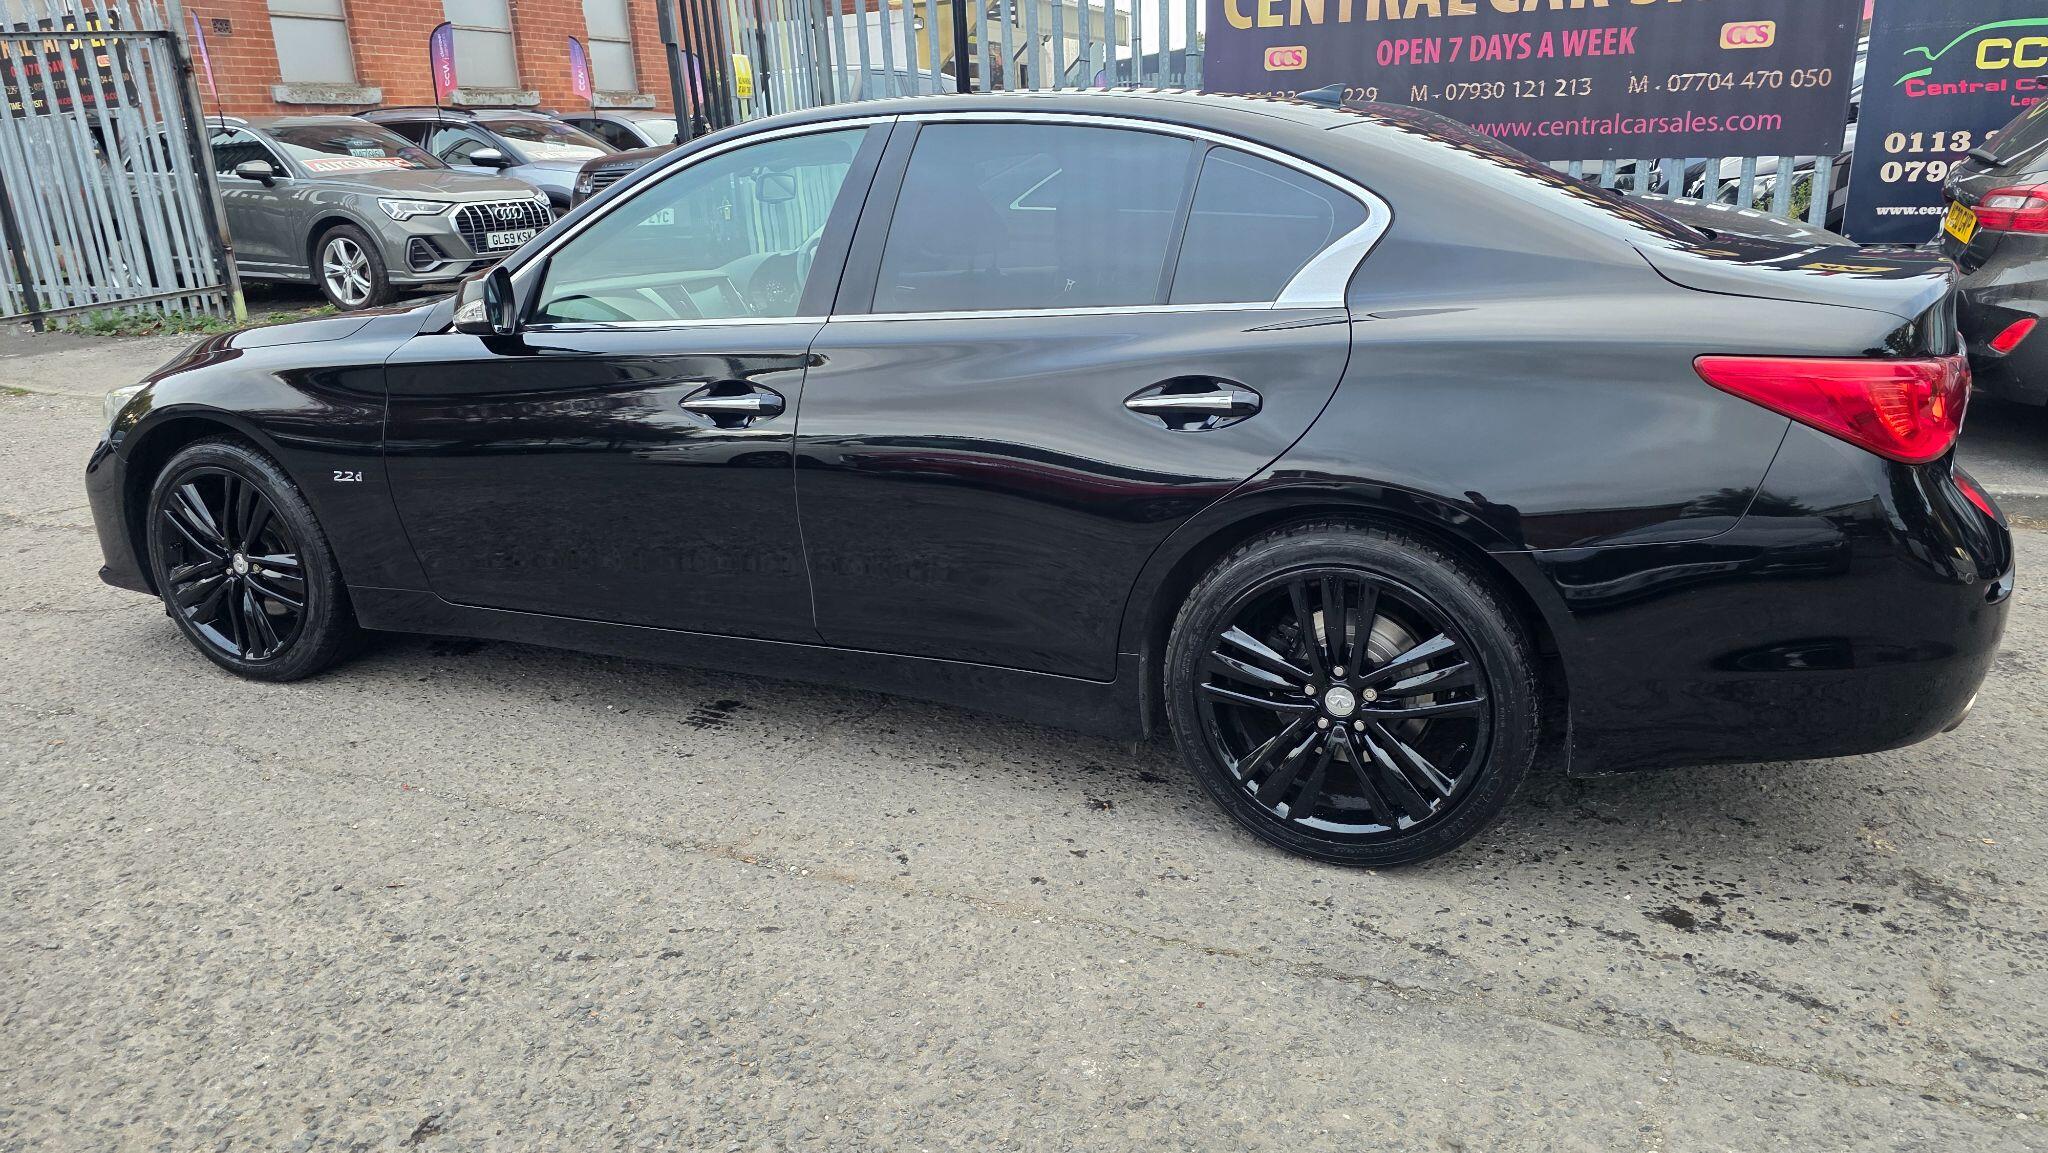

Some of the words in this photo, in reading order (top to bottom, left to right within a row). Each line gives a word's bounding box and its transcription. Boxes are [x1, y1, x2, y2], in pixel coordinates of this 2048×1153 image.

[1726, 25, 1770, 45] CCS
[1377, 38, 1442, 66] OPEN
[1448, 37, 1463, 63] 7
[1469, 33, 1532, 62] DAYS
[1537, 32, 1554, 58] A
[1562, 27, 1638, 57] WEEK
[1269, 50, 1304, 67] CCS
[1411, 85, 1428, 101] M
[1445, 82, 1505, 101] 07930
[1513, 80, 1546, 98] 121
[1555, 77, 1593, 97] 213
[1628, 73, 1649, 94] M
[1667, 71, 1735, 92] 07704
[1739, 70, 1783, 89] 470
[1790, 68, 1832, 88] 050
[1905, 78, 2007, 98] Central
[2011, 95, 2041, 106] Lee
[1472, 110, 1783, 137] www.centralcarsales.com
[1884, 131, 1972, 153] 0113
[492, 233, 515, 245] GL69
